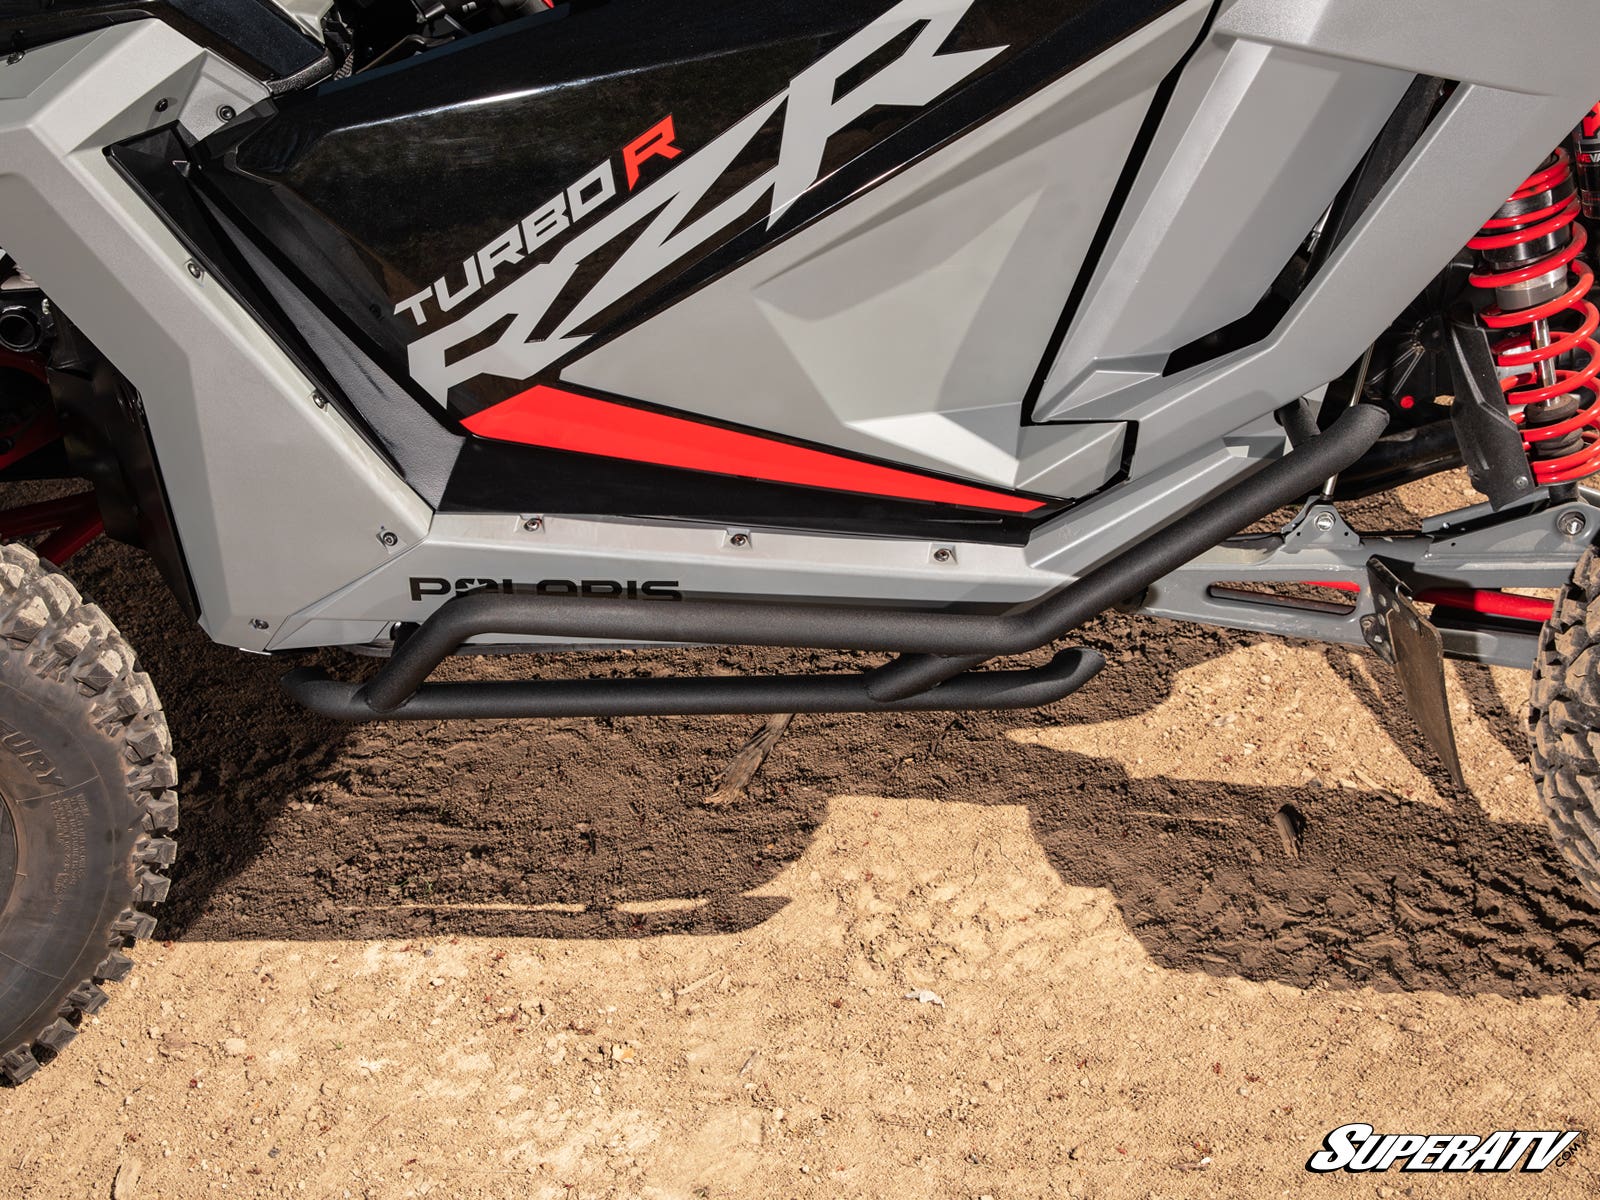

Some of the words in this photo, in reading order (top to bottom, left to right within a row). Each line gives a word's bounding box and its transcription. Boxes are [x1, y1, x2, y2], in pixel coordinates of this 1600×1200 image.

[393, 158, 616, 326] TURBO
[622, 114, 683, 192] R
[407, 0, 1010, 410] RZR
